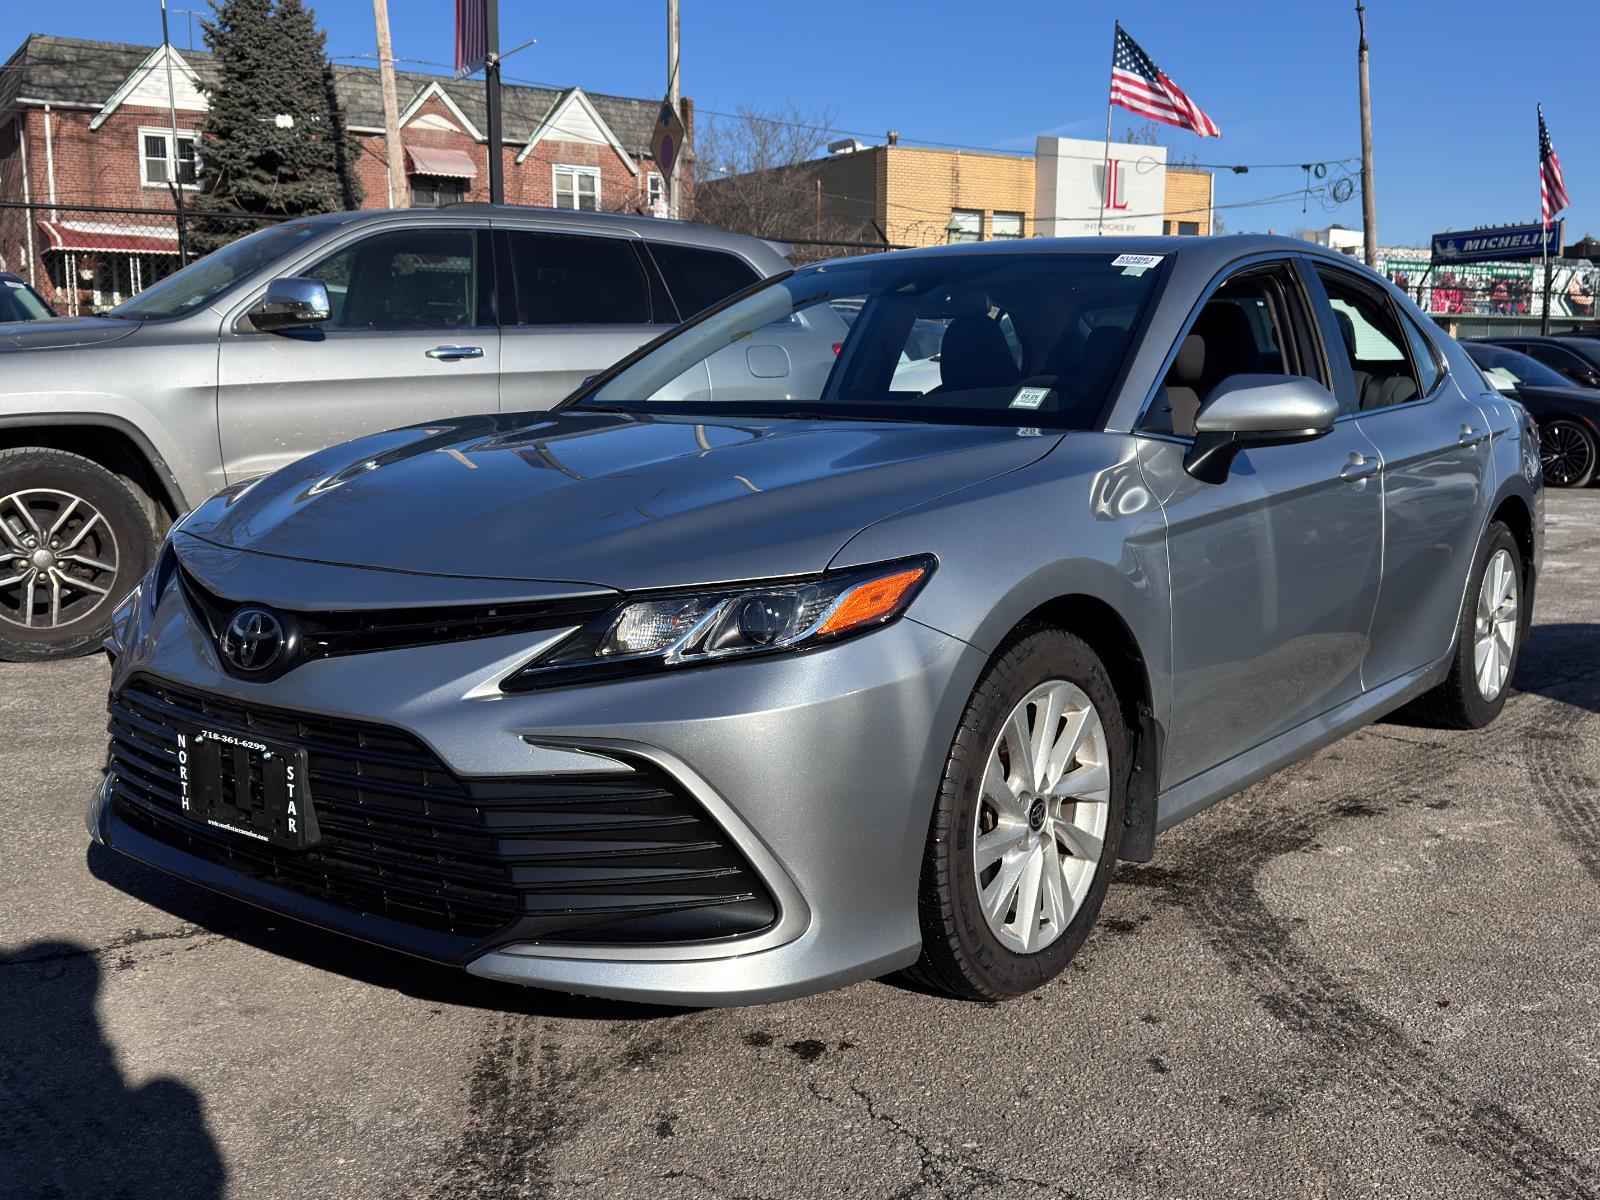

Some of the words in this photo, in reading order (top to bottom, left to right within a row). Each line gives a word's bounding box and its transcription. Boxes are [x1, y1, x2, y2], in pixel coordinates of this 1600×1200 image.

[1463, 232, 1554, 250] MICHELIN
[201, 730, 267, 751] 718-361-6299
[177, 734, 190, 810] NORTH
[286, 766, 297, 833] STAR
